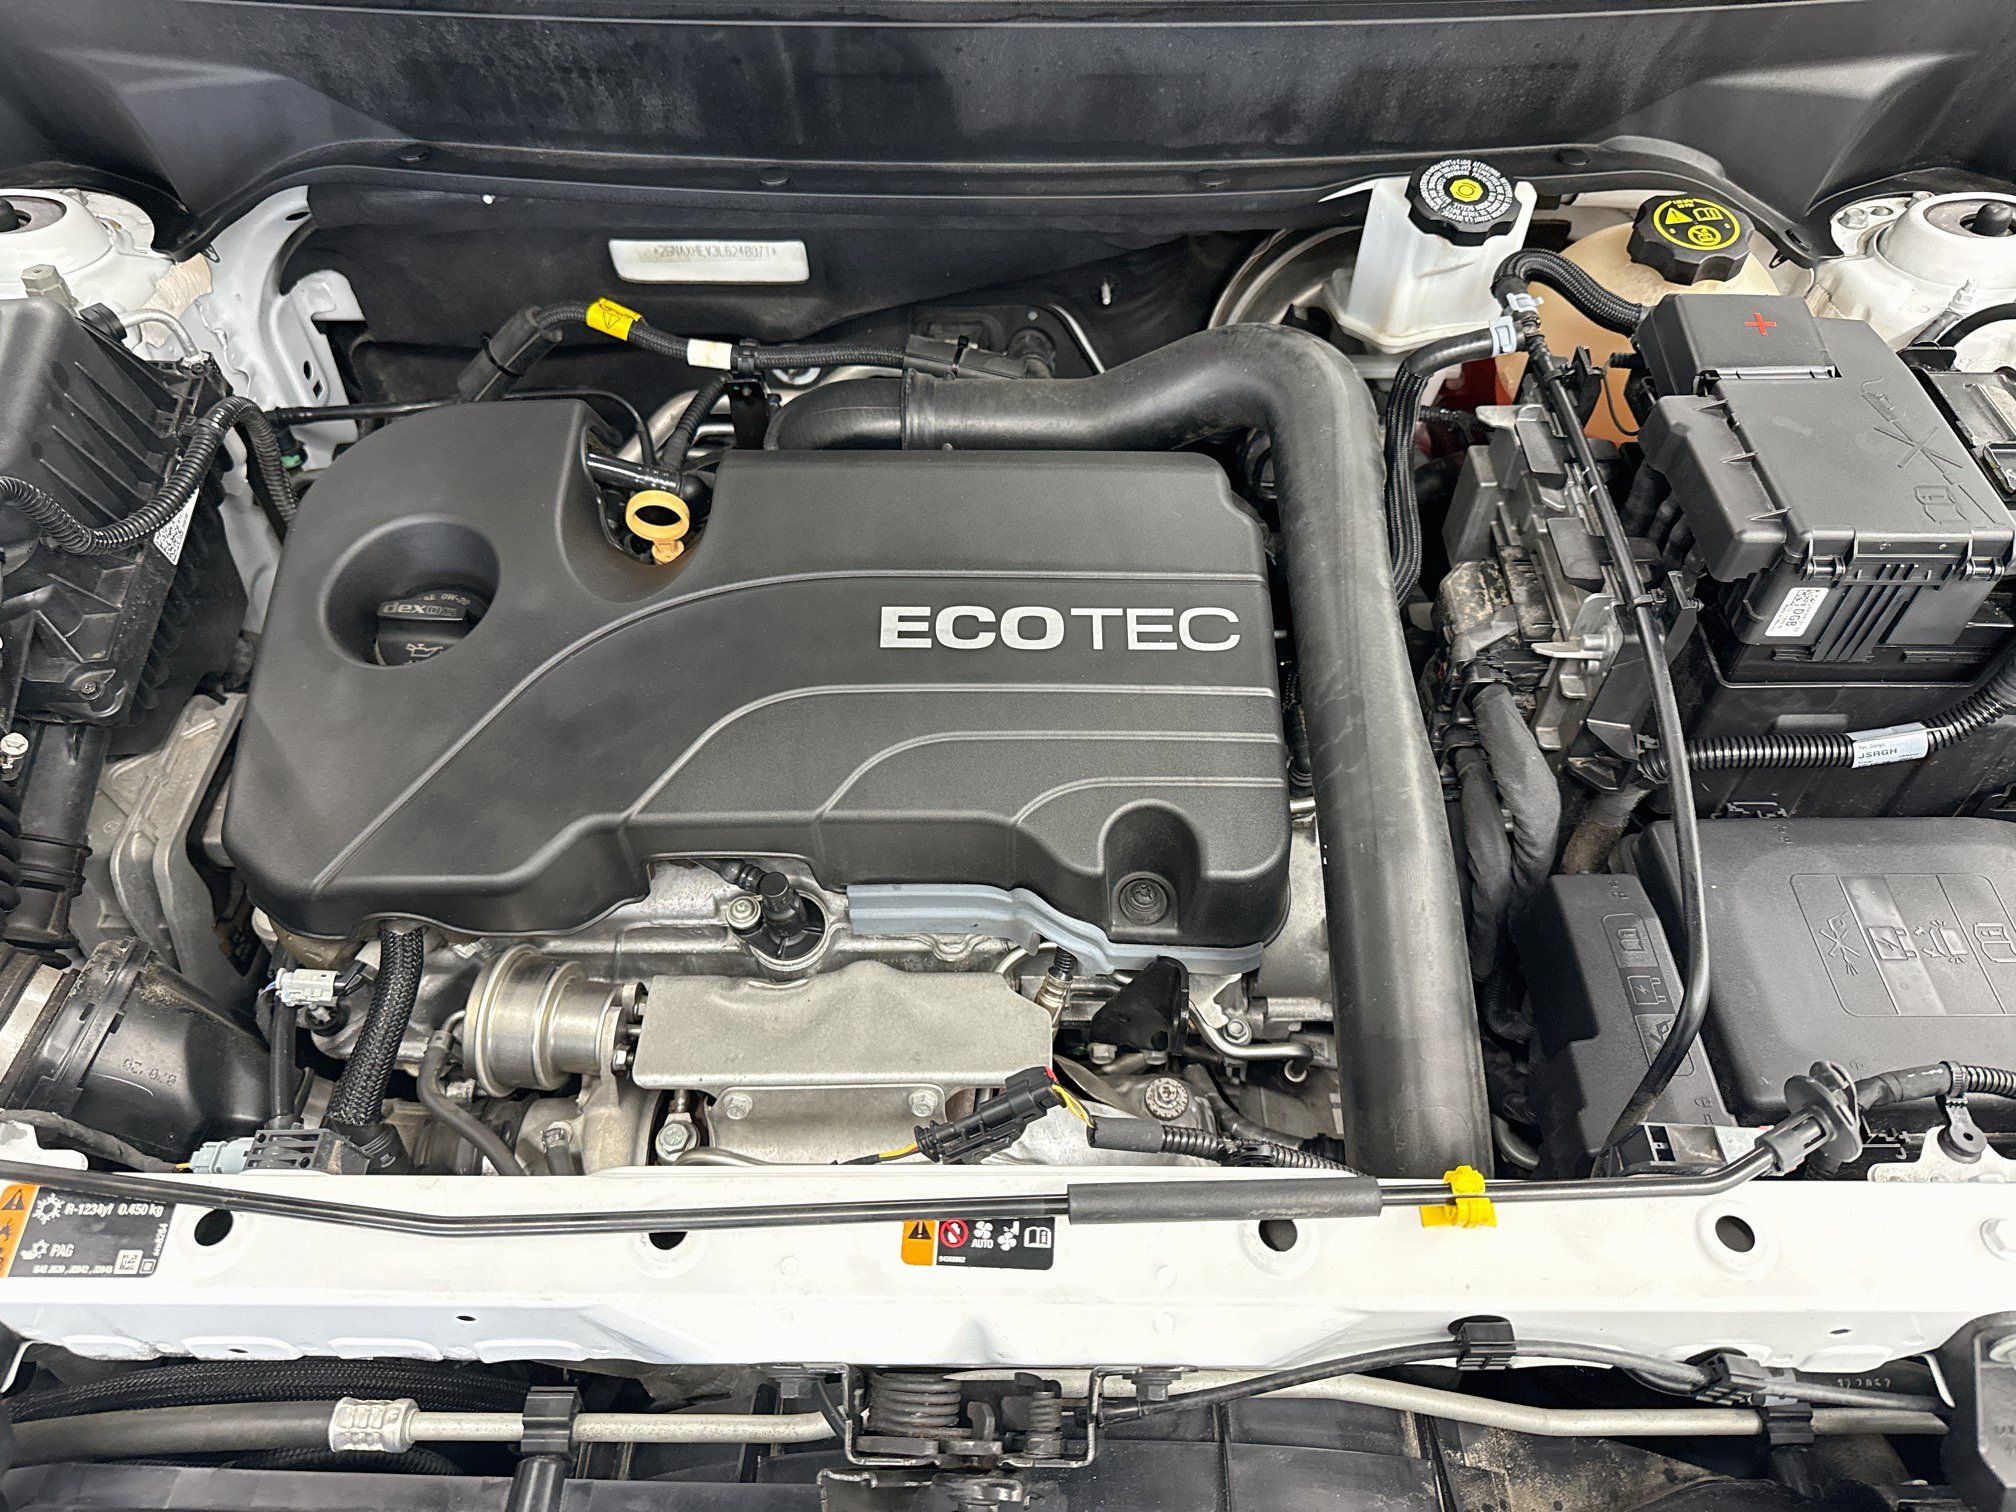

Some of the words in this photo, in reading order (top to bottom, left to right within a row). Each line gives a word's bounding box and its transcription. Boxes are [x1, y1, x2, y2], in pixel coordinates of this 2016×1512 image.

[382, 602, 458, 616] dexos
[879, 605, 1241, 651] ECOTEC
[1858, 747, 1898, 759] JSRGH
[64, 1203, 114, 1218] R-1234yf
[117, 1203, 149, 1216] 0.450
[149, 1204, 165, 1218] kg
[49, 1243, 75, 1258] PAG
[971, 1239, 994, 1249] AUTO
